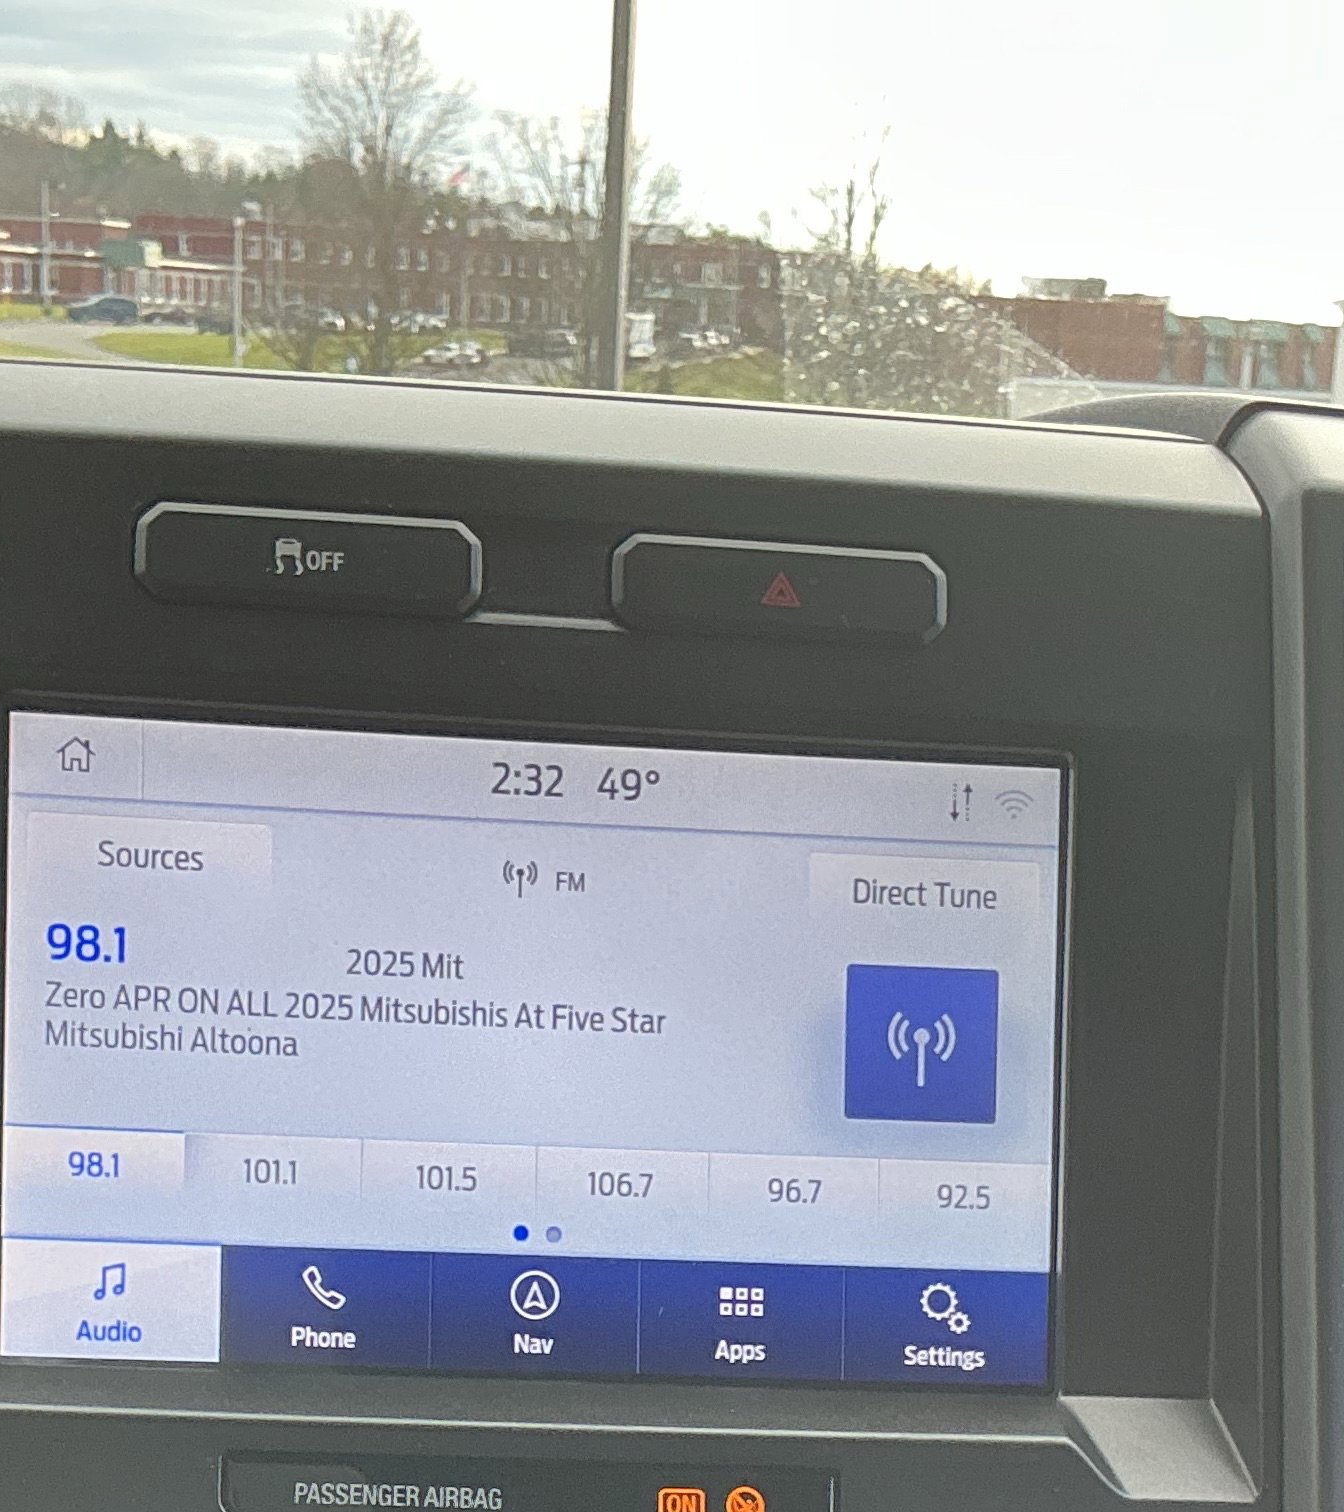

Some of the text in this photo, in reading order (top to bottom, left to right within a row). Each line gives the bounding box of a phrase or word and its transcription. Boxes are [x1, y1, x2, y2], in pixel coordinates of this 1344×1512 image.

[306, 550, 344, 571] OFF
[490, 761, 661, 800] 2:32 49°
[98, 840, 204, 872] Sources
[556, 870, 586, 891] FM
[852, 877, 998, 908] Direct Tune
[45, 921, 127, 962] 98.1
[345, 947, 464, 977] 2025 Mit
[44, 980, 667, 1032] Zero APR ON ALL 2025 Mitsubishis At Five Star
[44, 1019, 299, 1056] Mitsubishi Altoona
[67, 1151, 992, 1208] 98.1 101.1 101.5 106.7 96.7 92.5
[75, 1318, 142, 1343] Audio
[290, 1324, 356, 1349] Phone
[513, 1332, 554, 1355] Nav
[715, 1337, 767, 1365] Apps
[903, 1342, 985, 1370] Settings
[294, 1480, 503, 1510] PASSENGER AIRBAG
